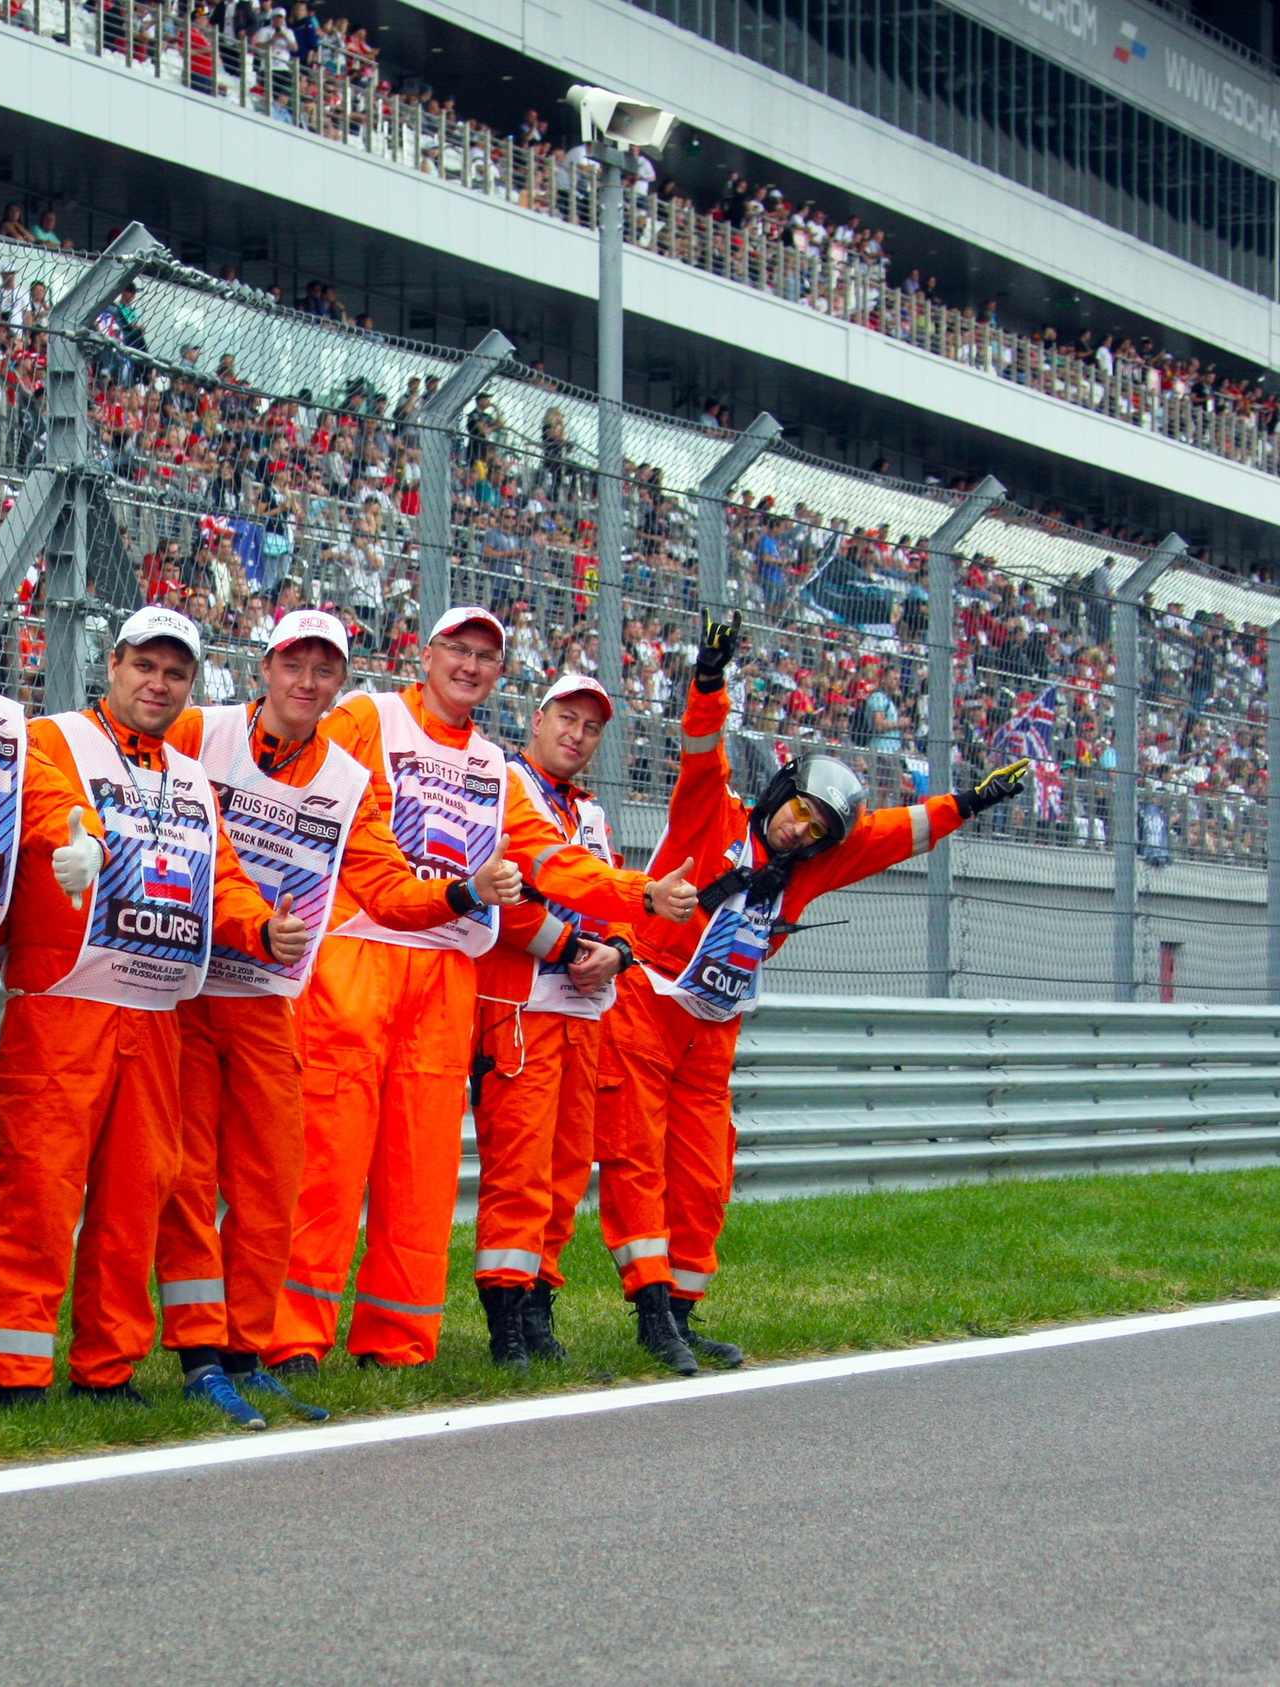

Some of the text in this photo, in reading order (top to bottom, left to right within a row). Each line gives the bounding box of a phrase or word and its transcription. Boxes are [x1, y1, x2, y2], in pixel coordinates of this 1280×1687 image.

[231, 794, 294, 826] RUS1050
[229, 829, 294, 859] TRACK MARSHAL
[299, 820, 338, 840] 2018
[117, 907, 200, 946] COURSE
[111, 962, 130, 974] VTB
[128, 967, 164, 983] RUSSIAN
